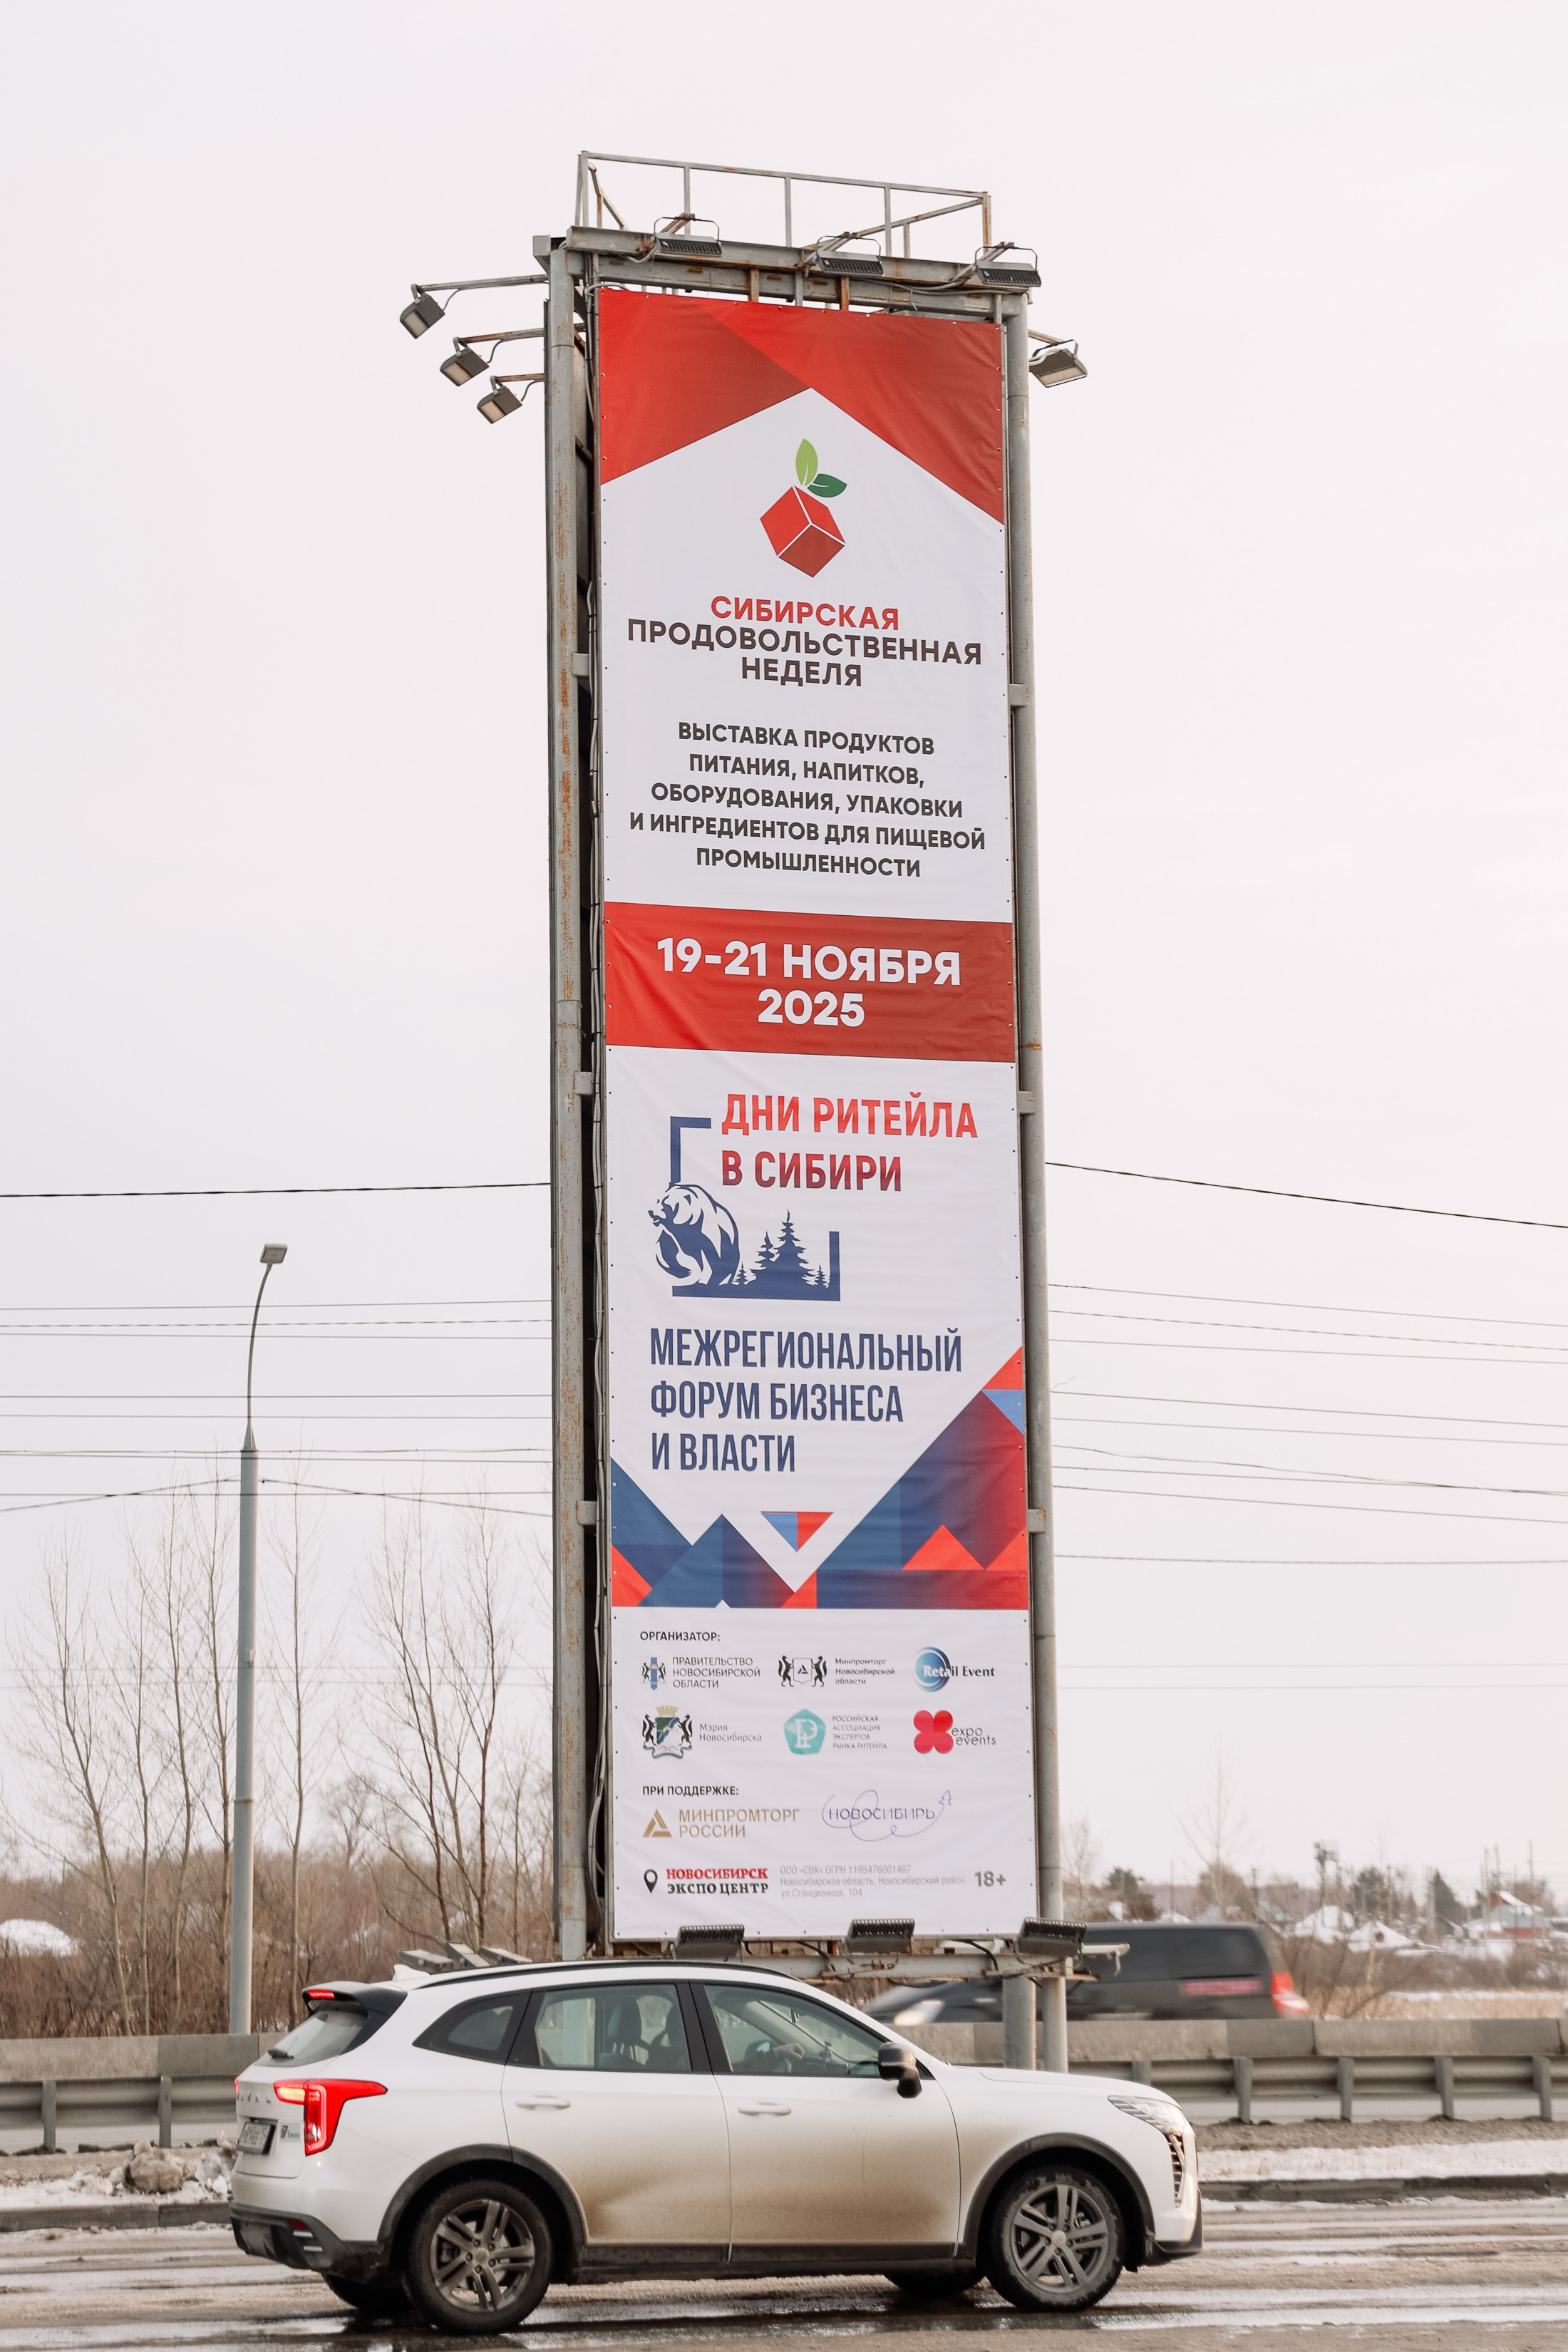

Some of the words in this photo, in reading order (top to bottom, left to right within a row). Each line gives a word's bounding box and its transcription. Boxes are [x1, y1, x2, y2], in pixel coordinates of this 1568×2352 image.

[711, 596, 899, 631] СИБИРСКАЯ
[627, 618, 982, 665] ПРОДОВОЛЬСТВЕННАЯ
[741, 656, 862, 687] НЕДЕЛЯ
[678, 722, 798, 747] ВЫСТАВКА
[804, 730, 935, 755] ПРОДУКТОВ
[689, 753, 797, 780] ПИТАНИЯ,
[803, 760, 924, 788] НАПИТКОВ,
[651, 783, 840, 814] ОБОРУДОВАНИЯ,
[847, 794, 963, 817] УПАКОВКИ
[630, 813, 644, 830] И
[650, 813, 819, 841] ИНГРЕДИЕНТОВ
[824, 825, 870, 845] ДЛЯ
[875, 825, 985, 850] ПИЩЕВОЙ
[696, 847, 920, 877] ПРОМЫШЛЕННОСТИ
[656, 937, 768, 977] 19-21
[783, 943, 961, 987] НОЯБРЯ
[758, 989, 865, 1027] 2025
[721, 1093, 799, 1136] ДНИ
[813, 1091, 979, 1139] РИТЕЙЛА
[721, 1150, 742, 1187] В
[755, 1151, 902, 1192] СИБИРИ
[650, 1327, 962, 1373] МЕЖРЕГИОНАЛЬНЫЙ
[651, 1381, 760, 1419] ФОРУМ
[770, 1383, 904, 1423] БИЗНЕСА
[651, 1432, 670, 1470] И
[679, 1433, 796, 1472] ВЛАСТИ
[640, 1631, 721, 1641] ОРГАНИЗАТОР:
[672, 1657, 753, 1666] ПРАВИТЕЛЬСТВО
[835, 1658, 887, 1666] Минпромторг
[673, 1667, 760, 1677] НОВОСИБИРСКОЙ
[835, 1668, 894, 1676] Новосибирской
[924, 1665, 959, 1678] Retail
[962, 1666, 995, 1677] Event
[673, 1680, 718, 1688] ОБЛАСТИ
[700, 1723, 728, 1732] Мэрия
[951, 1727, 983, 1738] expo
[699, 1733, 762, 1743] Новосибирска
[956, 1735, 996, 1745] events
[642, 1786, 664, 1795] ПРИ
[668, 1785, 738, 1797] ПОДДЕРЖКЕ:
[679, 1808, 799, 1822] МИНПРОМТОРГ
[829, 1808, 935, 1820] НОВОСИБИРЬ
[679, 1825, 746, 1838] РОССИИ
[666, 1868, 768, 1880] НОВОСИБИРСК
[825, 1865, 845, 1874] ОГРН
[780, 1877, 840, 1887] Новосибирская
[878, 1876, 939, 1886] Новосибирский
[974, 1871, 1006, 1887] 18+
[848, 1888, 862, 1897] 104
